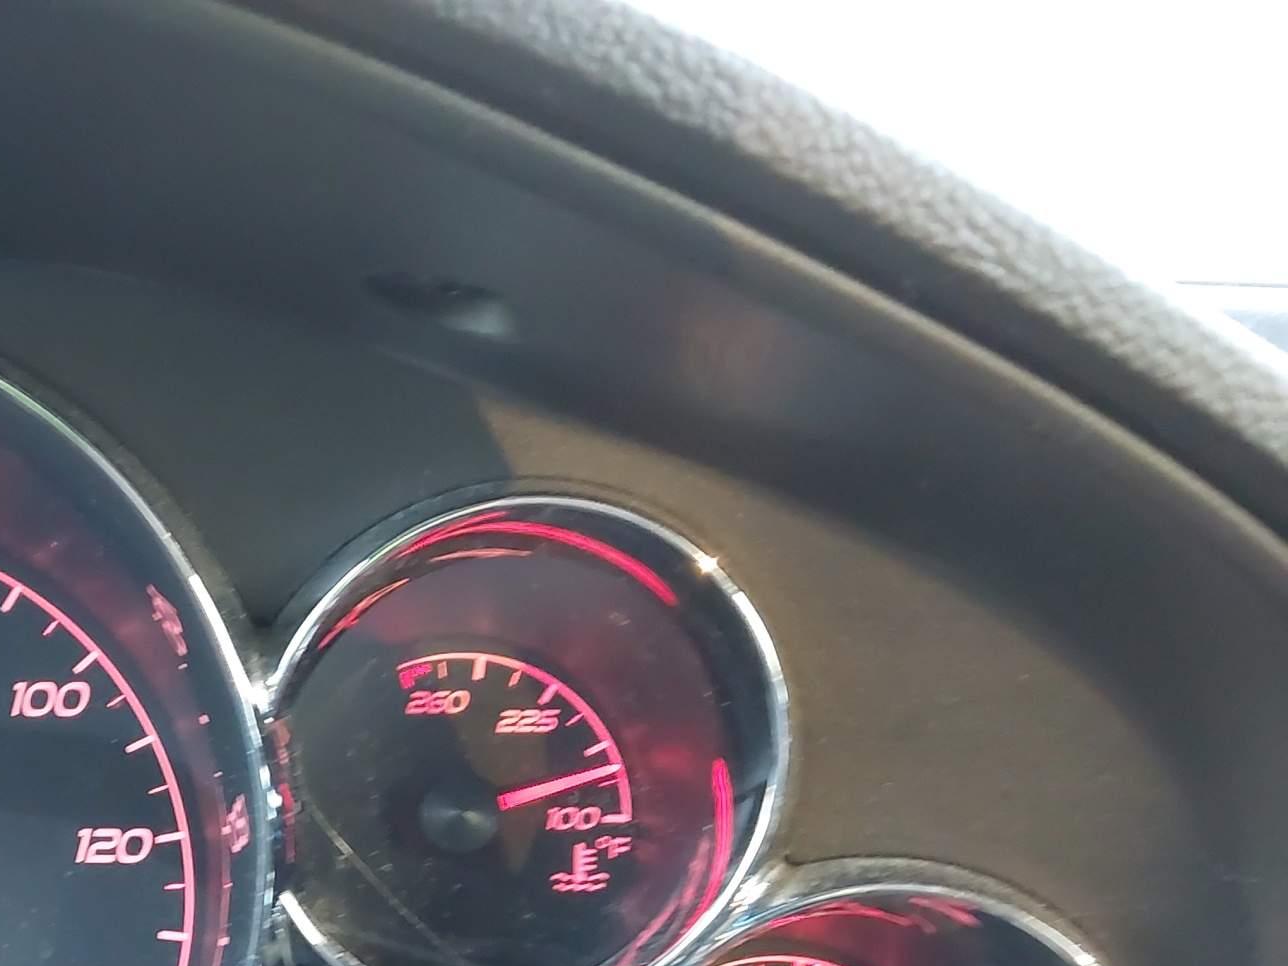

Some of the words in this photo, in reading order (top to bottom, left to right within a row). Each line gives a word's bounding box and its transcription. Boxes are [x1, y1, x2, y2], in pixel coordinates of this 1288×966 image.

[11, 682, 90, 717] 100
[406, 690, 471, 714] 260
[495, 709, 560, 733] 225
[545, 807, 602, 830] 100
[76, 828, 153, 863] 120
